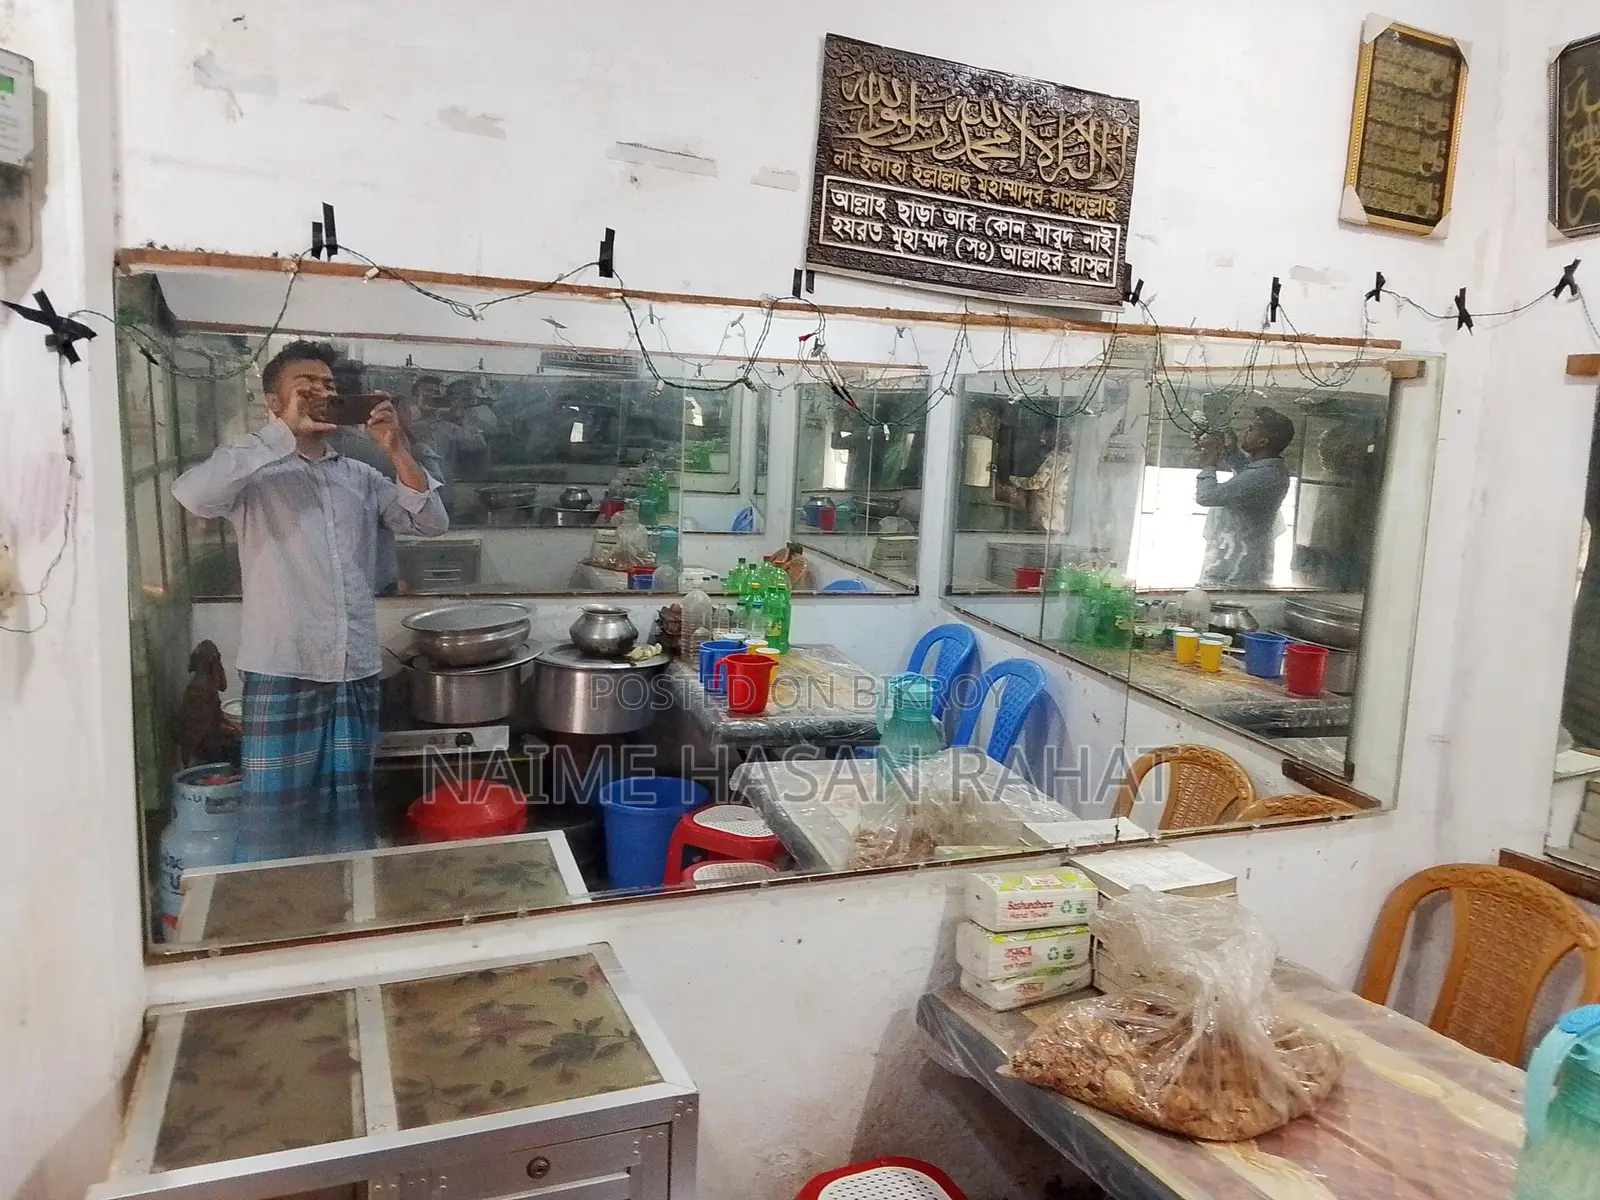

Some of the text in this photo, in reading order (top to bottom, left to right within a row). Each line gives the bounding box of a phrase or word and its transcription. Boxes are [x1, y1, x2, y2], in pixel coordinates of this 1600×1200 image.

[829, 214, 885, 242] হযরত
[888, 224, 948, 255] মুহাম্মদ
[999, 243, 1064, 272] আল্লাহর
[830, 189, 1115, 256] আল্লাহ ছাড়া আর কোন মাবুদ নাই
